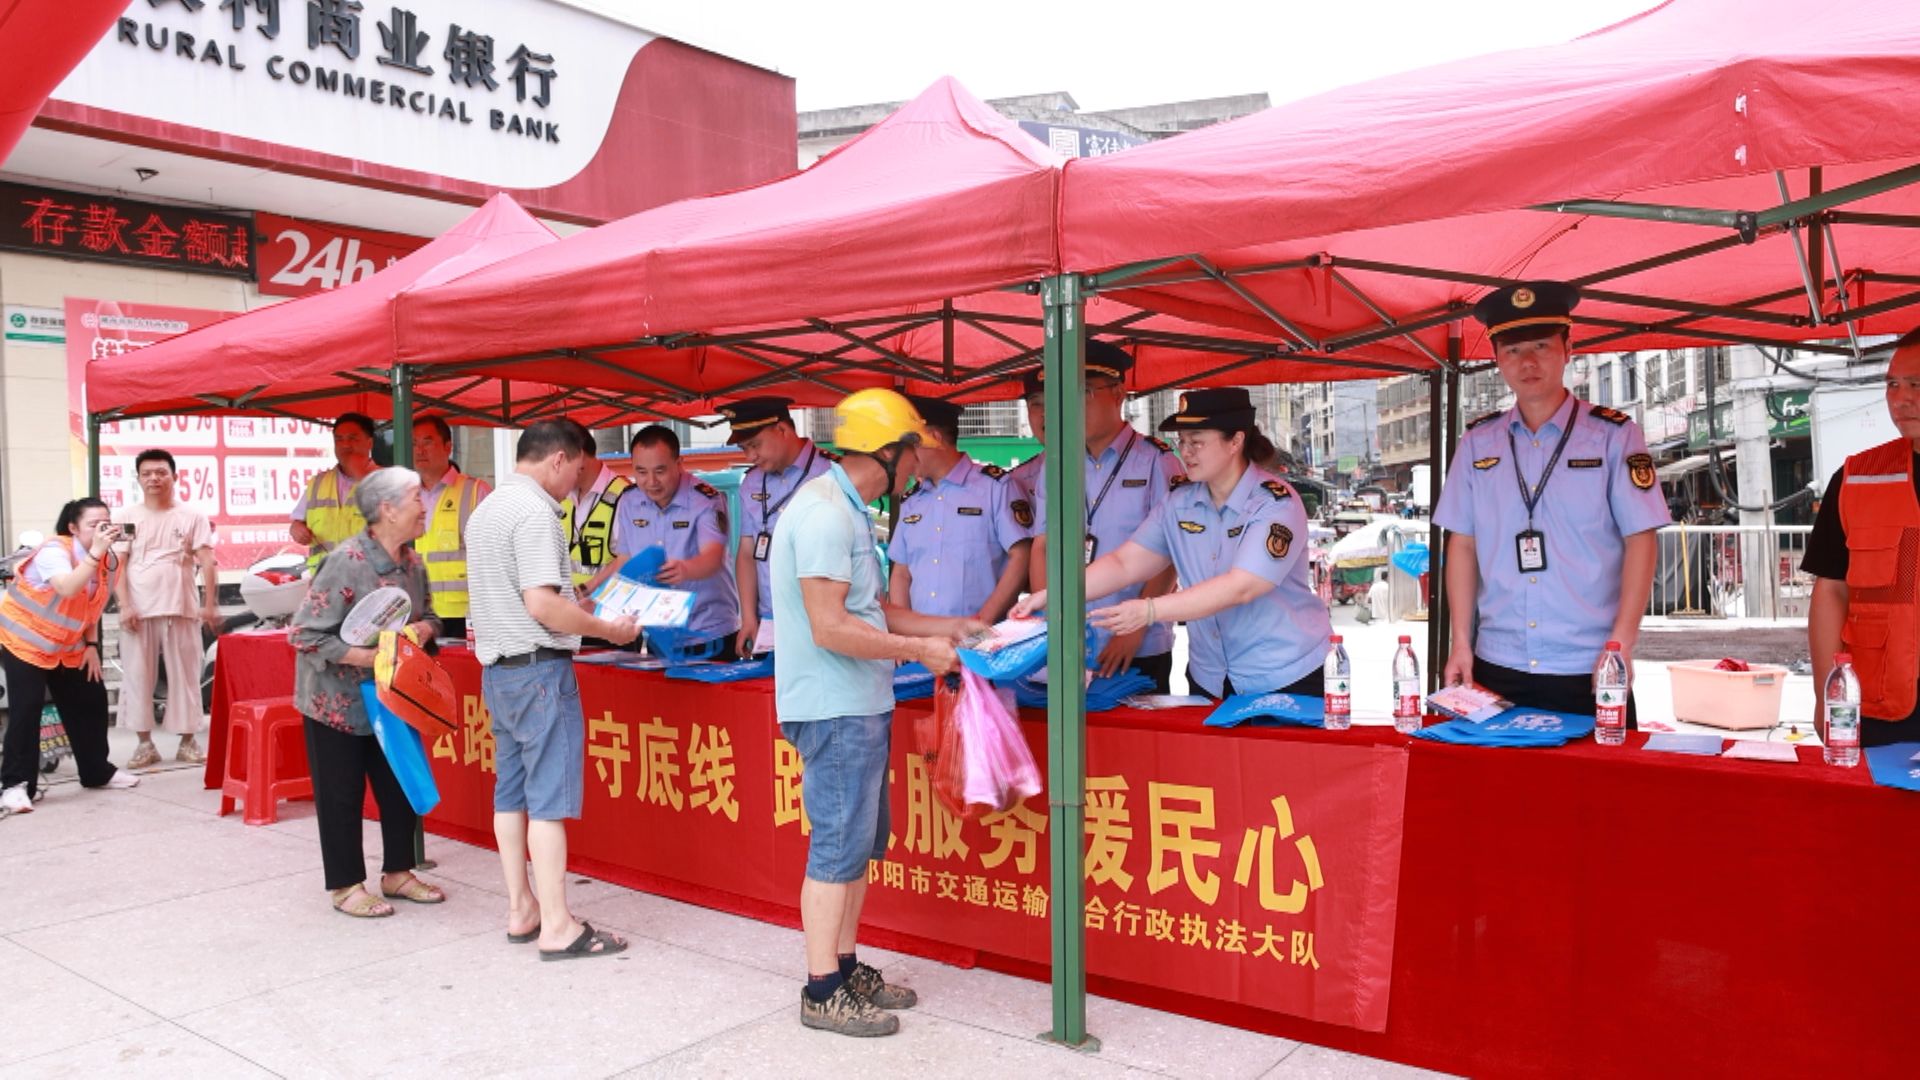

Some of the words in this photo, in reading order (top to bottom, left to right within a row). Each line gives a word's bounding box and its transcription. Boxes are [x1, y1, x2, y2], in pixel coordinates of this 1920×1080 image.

[117, 16, 247, 71] RURAL
[266, 55, 474, 125] COMMERCIAL
[489, 109, 561, 144] BANK
[269, 229, 375, 290] 24h
[869, 858, 1321, 970] 阳市交通运输合行政执法大队
